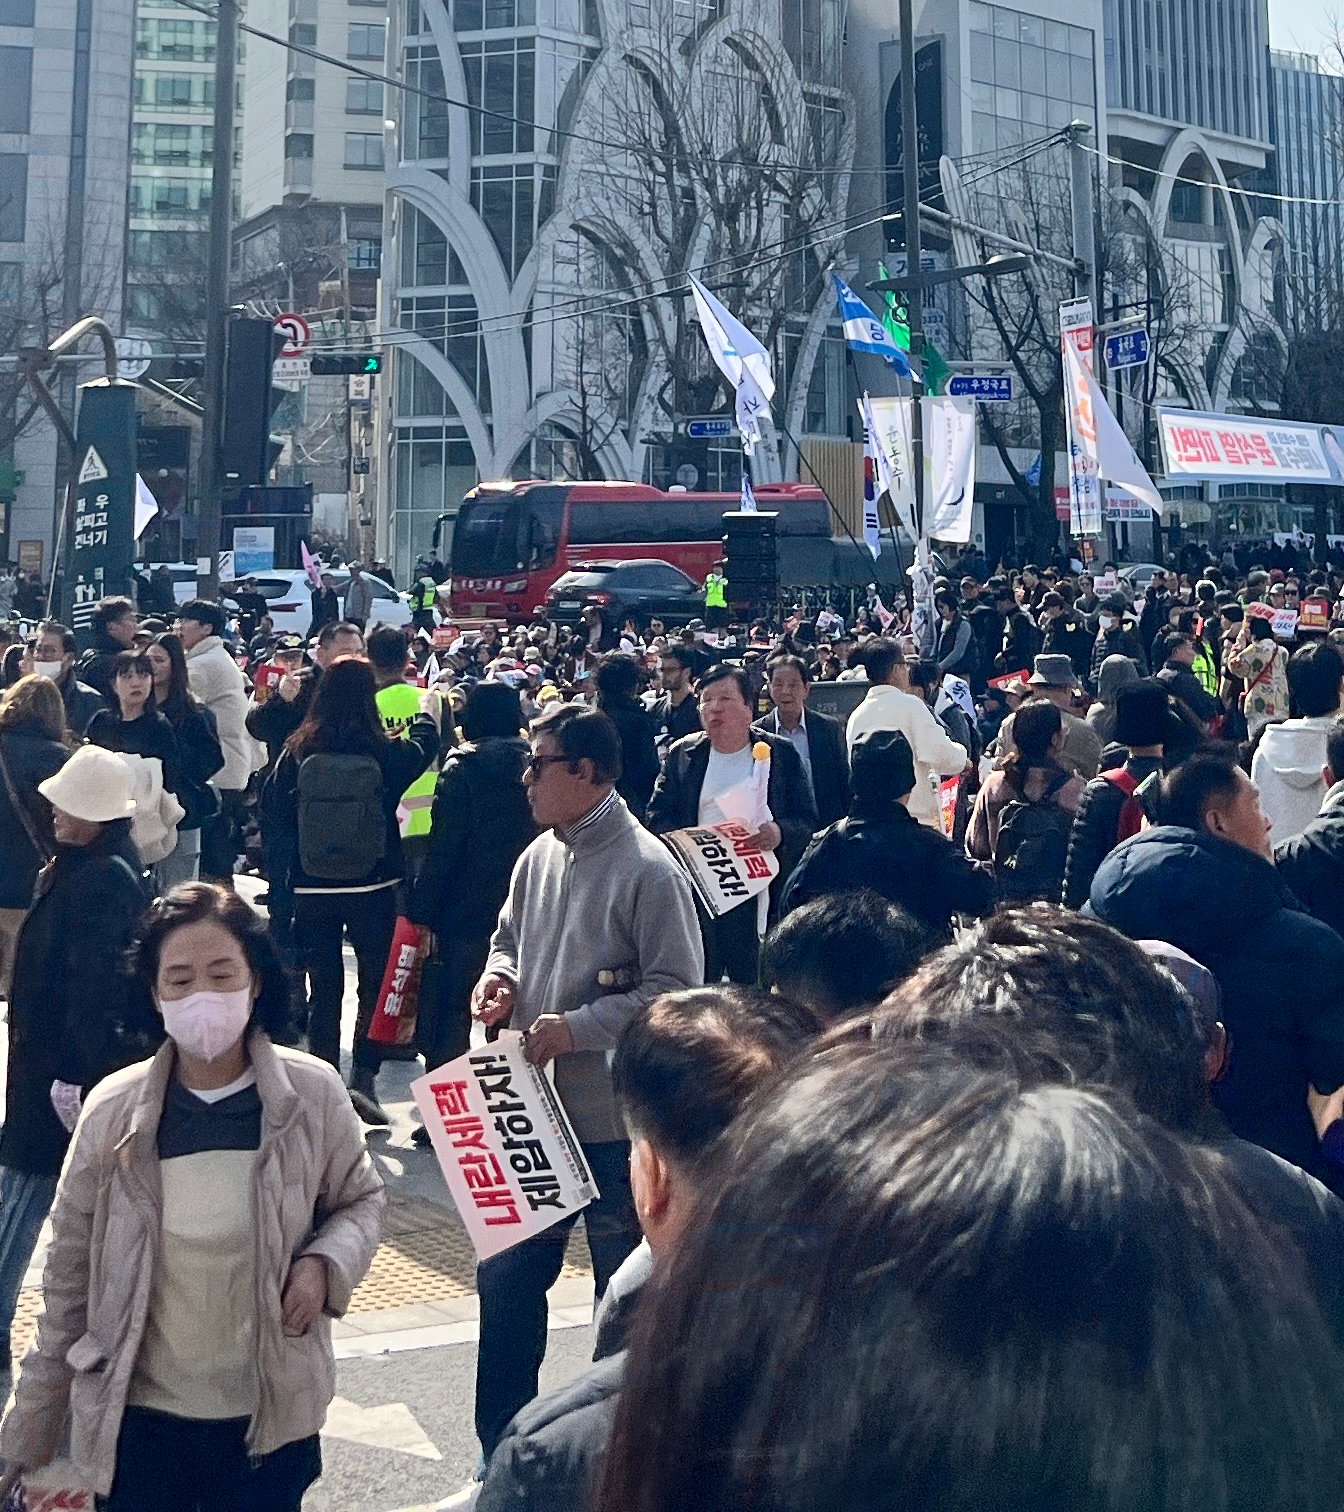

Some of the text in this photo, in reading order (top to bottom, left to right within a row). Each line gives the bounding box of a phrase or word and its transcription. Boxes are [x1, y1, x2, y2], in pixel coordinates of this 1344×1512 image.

[971, 379, 1009, 390] 우정국로
[886, 425, 905, 491] 윤동주
[95, 494, 109, 509] 우
[75, 511, 108, 533] 살피고
[74, 530, 108, 550] 건너기
[468, 1054, 567, 1212] 제압하자!
[430, 1080, 522, 1226] 내란세력
